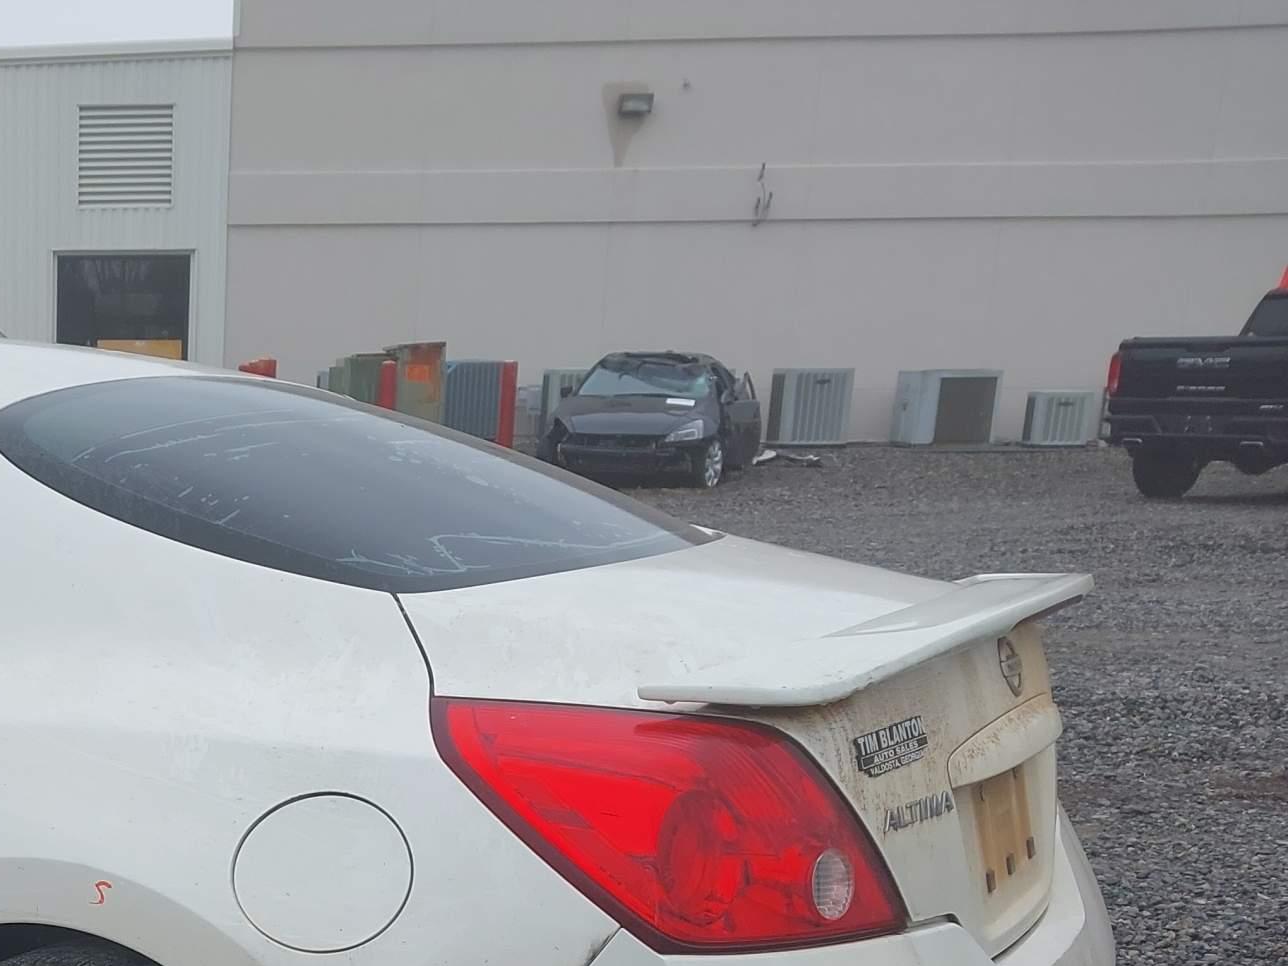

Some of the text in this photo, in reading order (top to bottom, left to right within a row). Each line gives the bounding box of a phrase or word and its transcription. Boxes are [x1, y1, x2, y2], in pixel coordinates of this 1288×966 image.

[858, 733, 879, 756] TIM
[873, 741, 919, 763] AUTO SALES
[884, 791, 953, 832] ALTIMA
